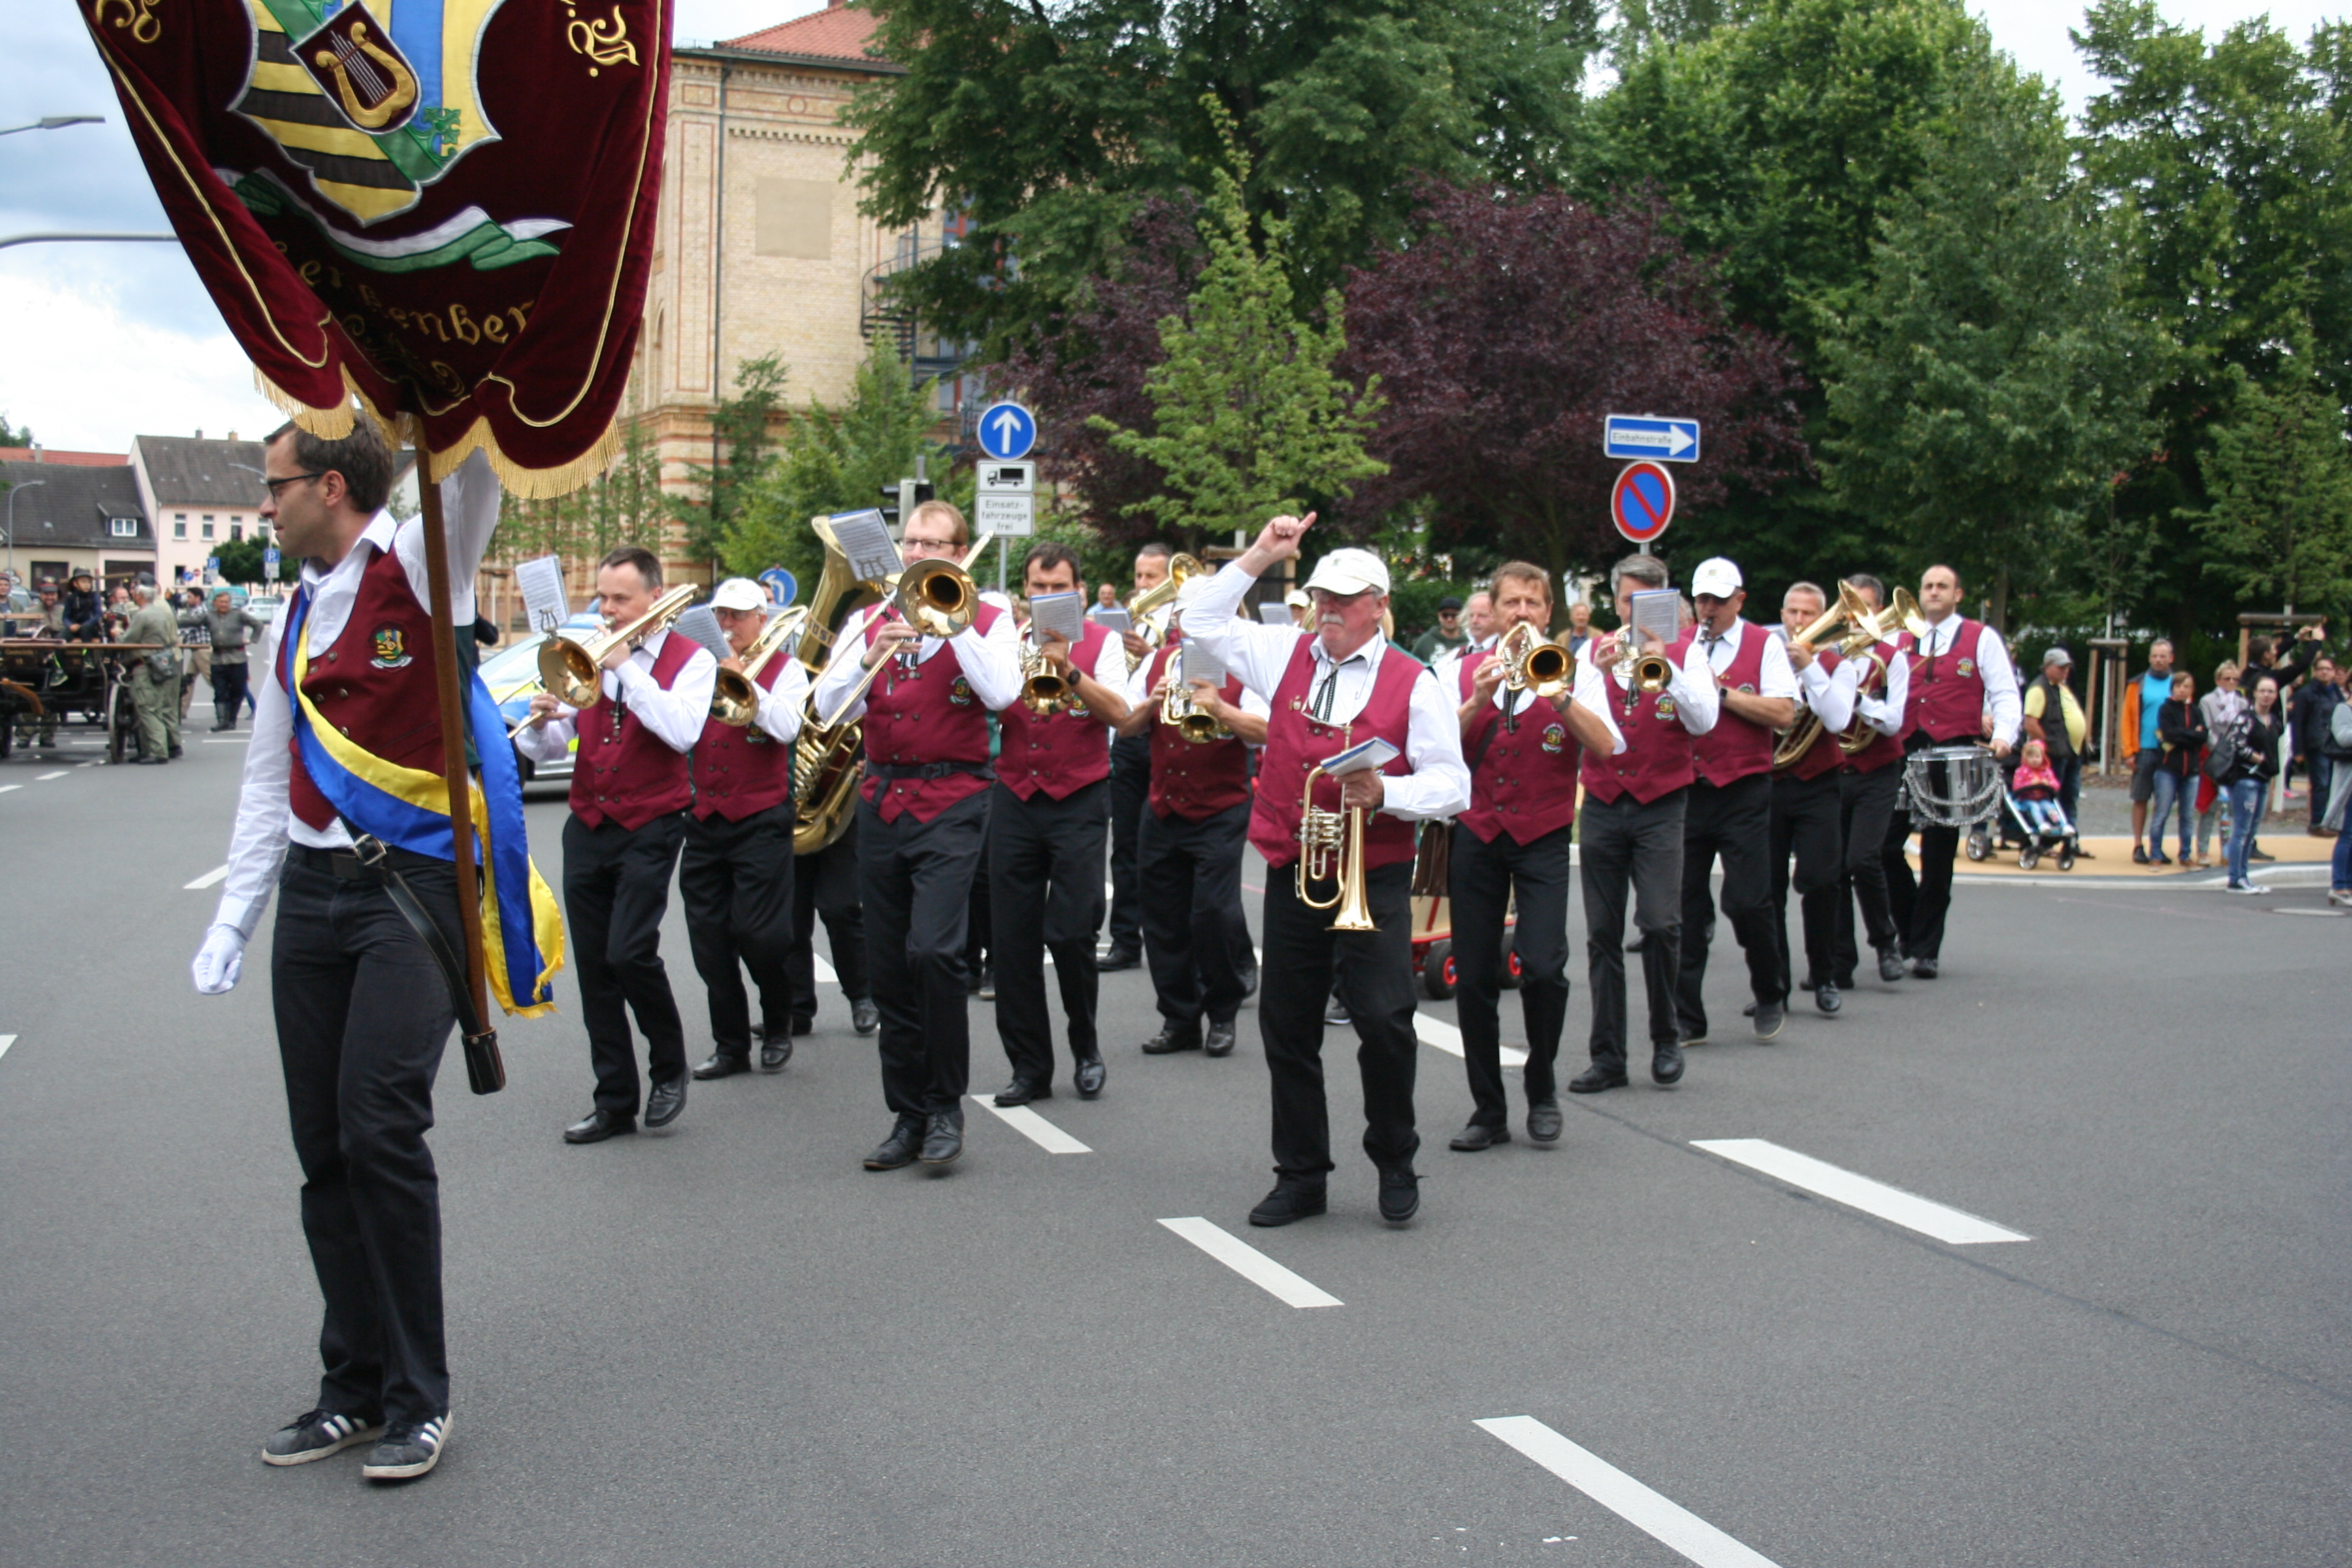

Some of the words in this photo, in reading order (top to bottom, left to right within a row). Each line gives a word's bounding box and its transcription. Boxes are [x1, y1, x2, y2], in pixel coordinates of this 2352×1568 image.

[1612, 431, 1672, 444] Einbahnstraße
[985, 500, 1024, 509] Einsatz-
[981, 511, 1028, 522] fahrzeuge
[996, 522, 1013, 531] frei
